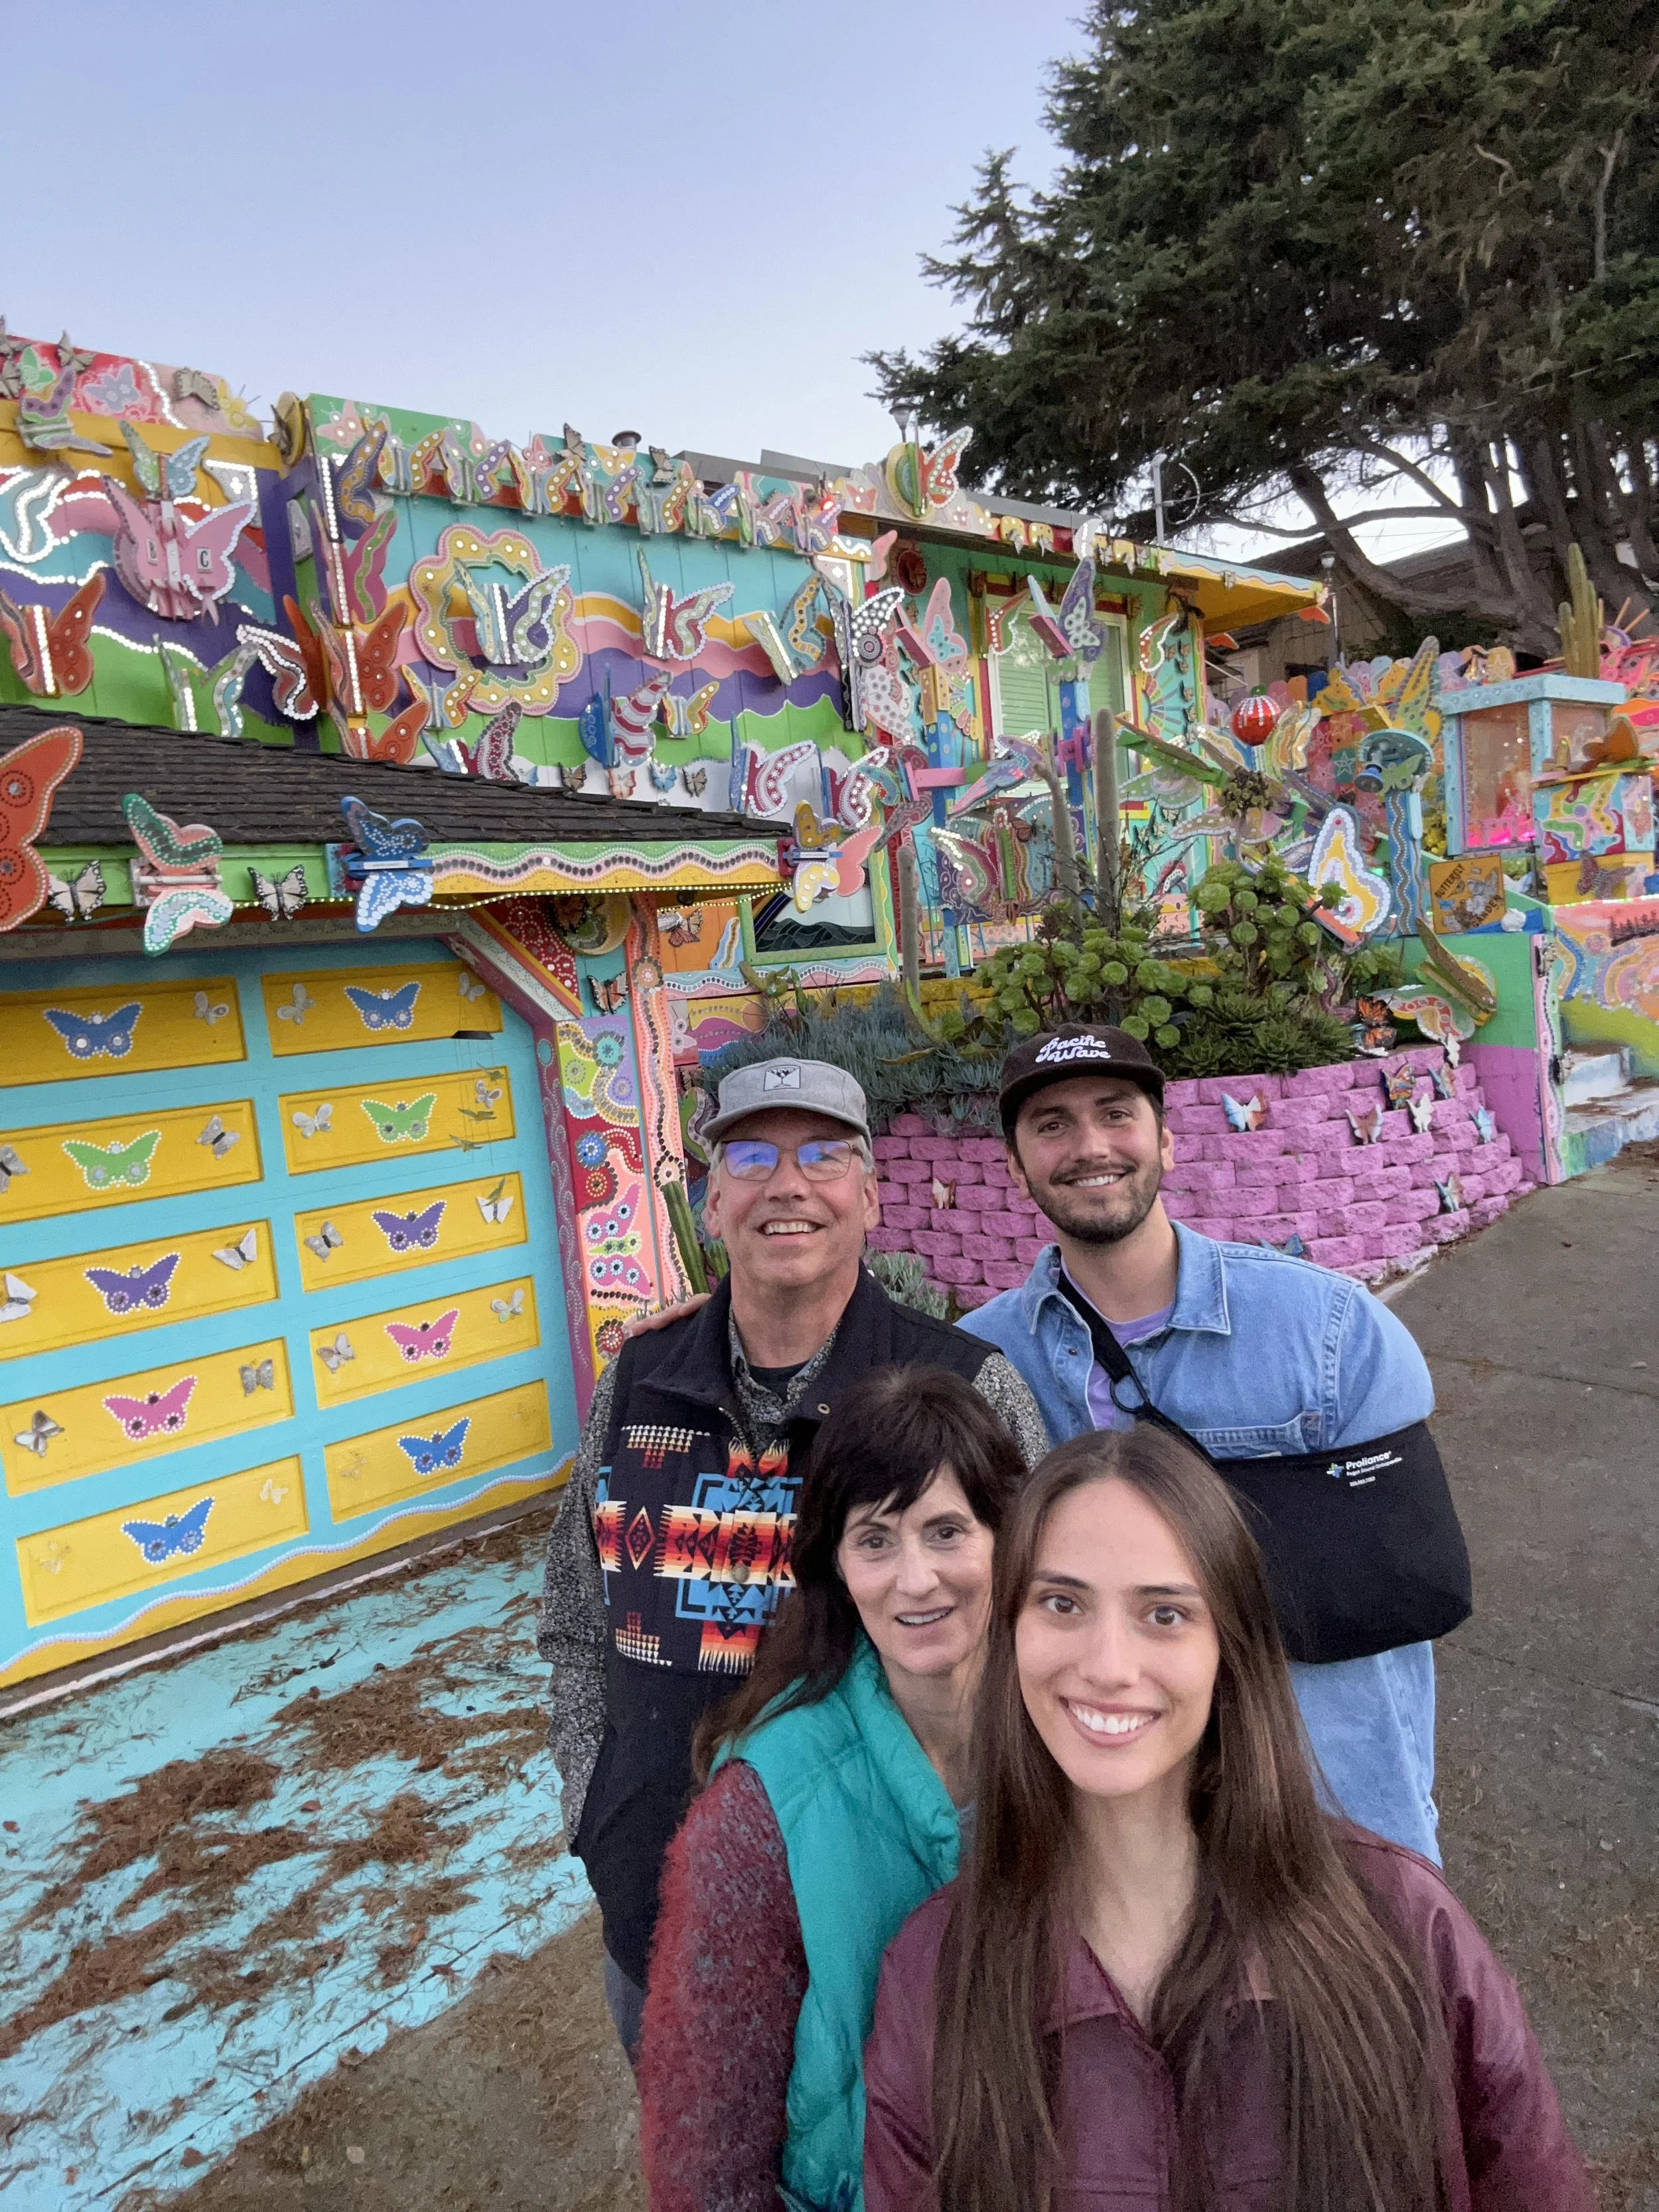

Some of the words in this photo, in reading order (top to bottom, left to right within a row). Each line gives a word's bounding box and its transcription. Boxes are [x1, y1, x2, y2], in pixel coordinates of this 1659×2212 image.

[200, 550, 209, 568] C
[1434, 863, 1465, 898] BUTTERFLY
[1035, 1035, 1106, 1063] Pacific
[1046, 1046, 1112, 1063] Wave
